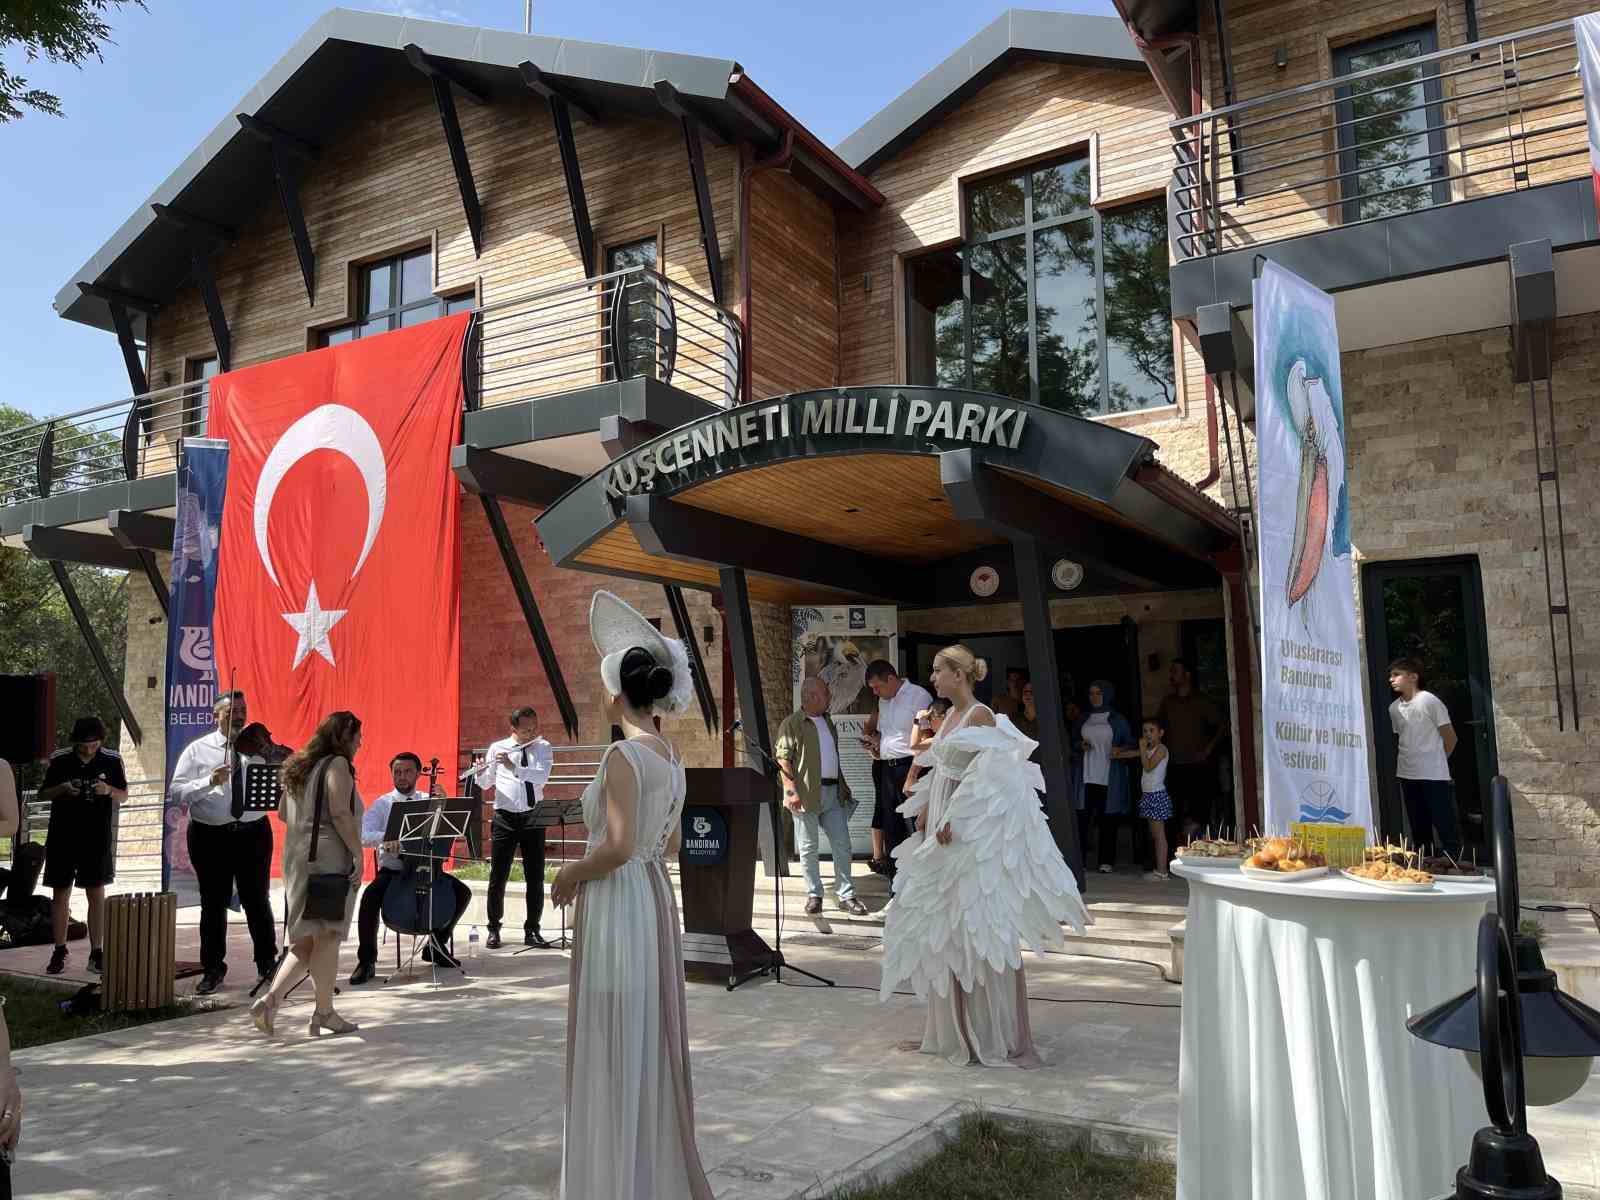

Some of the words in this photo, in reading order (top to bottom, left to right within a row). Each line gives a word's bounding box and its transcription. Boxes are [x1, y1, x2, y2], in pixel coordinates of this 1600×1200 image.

[905, 400, 1027, 449] PARKI
[170, 684, 214, 708] ANDI
[170, 712, 217, 725] BELED
[1275, 721, 1312, 744] Kültür
[1315, 729, 1328, 744] ve
[1331, 728, 1362, 749] Turizm
[686, 839, 720, 849] BANDIRMA
